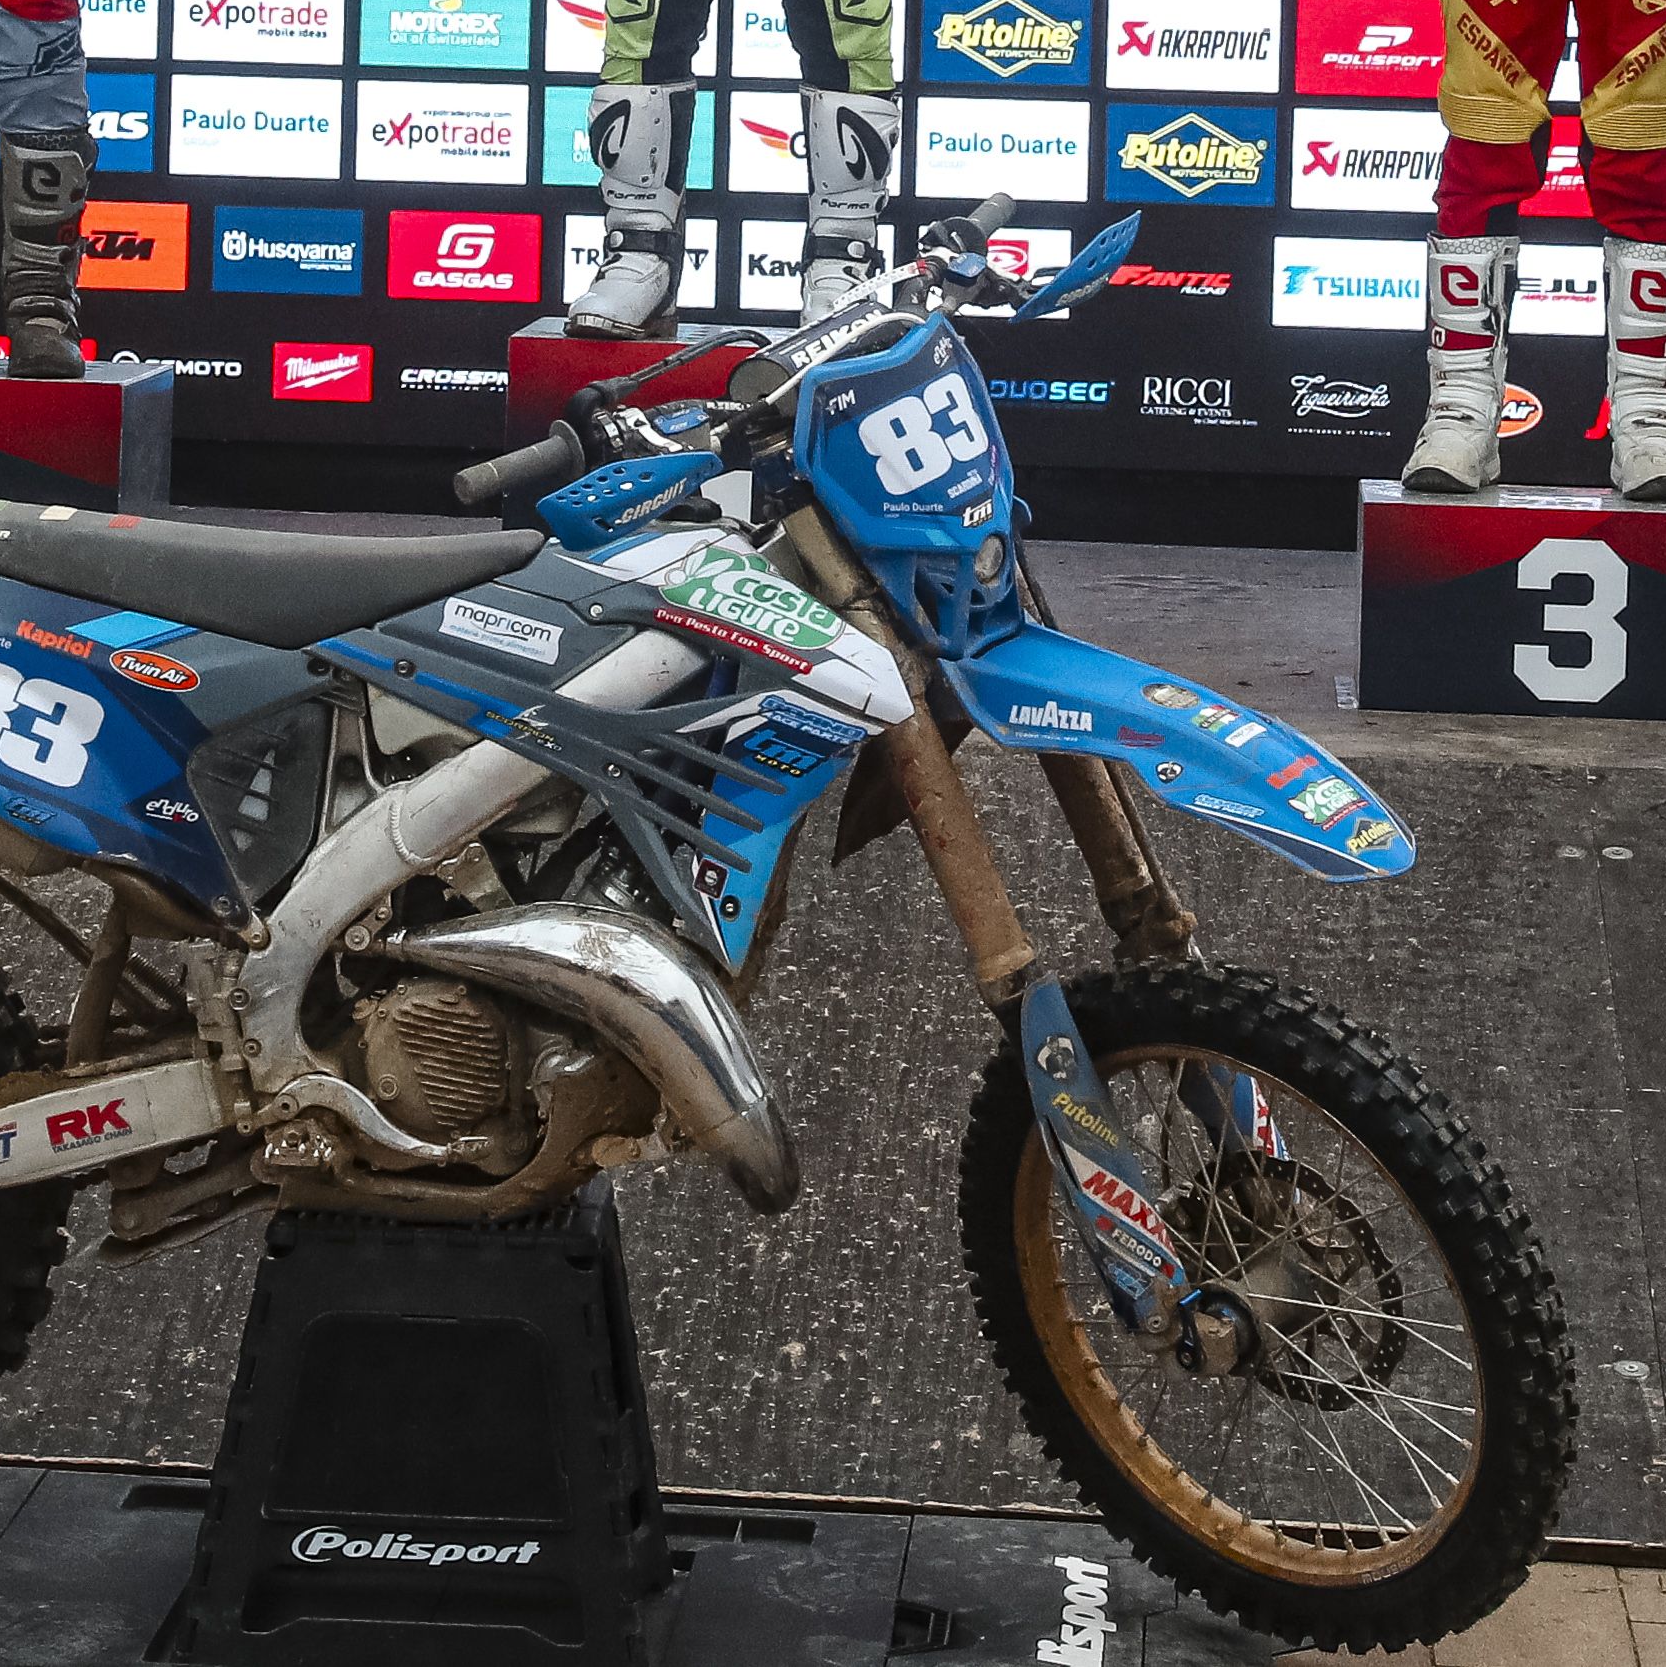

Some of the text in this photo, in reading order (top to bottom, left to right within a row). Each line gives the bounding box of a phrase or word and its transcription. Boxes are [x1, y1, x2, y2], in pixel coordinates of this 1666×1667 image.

[1457, 12, 1520, 89] ESPAÑA
[182, 109, 330, 133] Paulo Duarte
[248, 238, 354, 264] Husqvarna
[413, 271, 514, 290] GASGAS
[1107, 264, 1233, 289] FANTIC
[1180, 285, 1230, 296] RACING
[1313, 276, 1420, 299] TSUBAKI
[827, 389, 856, 416] FIM
[1143, 376, 1232, 407] RICCI
[858, 372, 989, 496] 83
[621, 479, 688, 525] CIRCUIT
[883, 502, 944, 513] Paulo Duarte
[454, 602, 553, 644] mapricom
[1513, 537, 1630, 704] 3
[16, 619, 94, 660] Kapriol
[656, 609, 683, 623] Pro
[730, 633, 758, 647] For
[762, 644, 808, 670] Sport
[1009, 700, 1093, 733] LAVAZZA
[1348, 821, 1394, 853] Putoline
[46, 1099, 132, 1149] RK
[1051, 1091, 1119, 1148] Putoline
[1112, 1227, 1163, 1268] FERODO
[304, 1532, 541, 1566] Polisport
